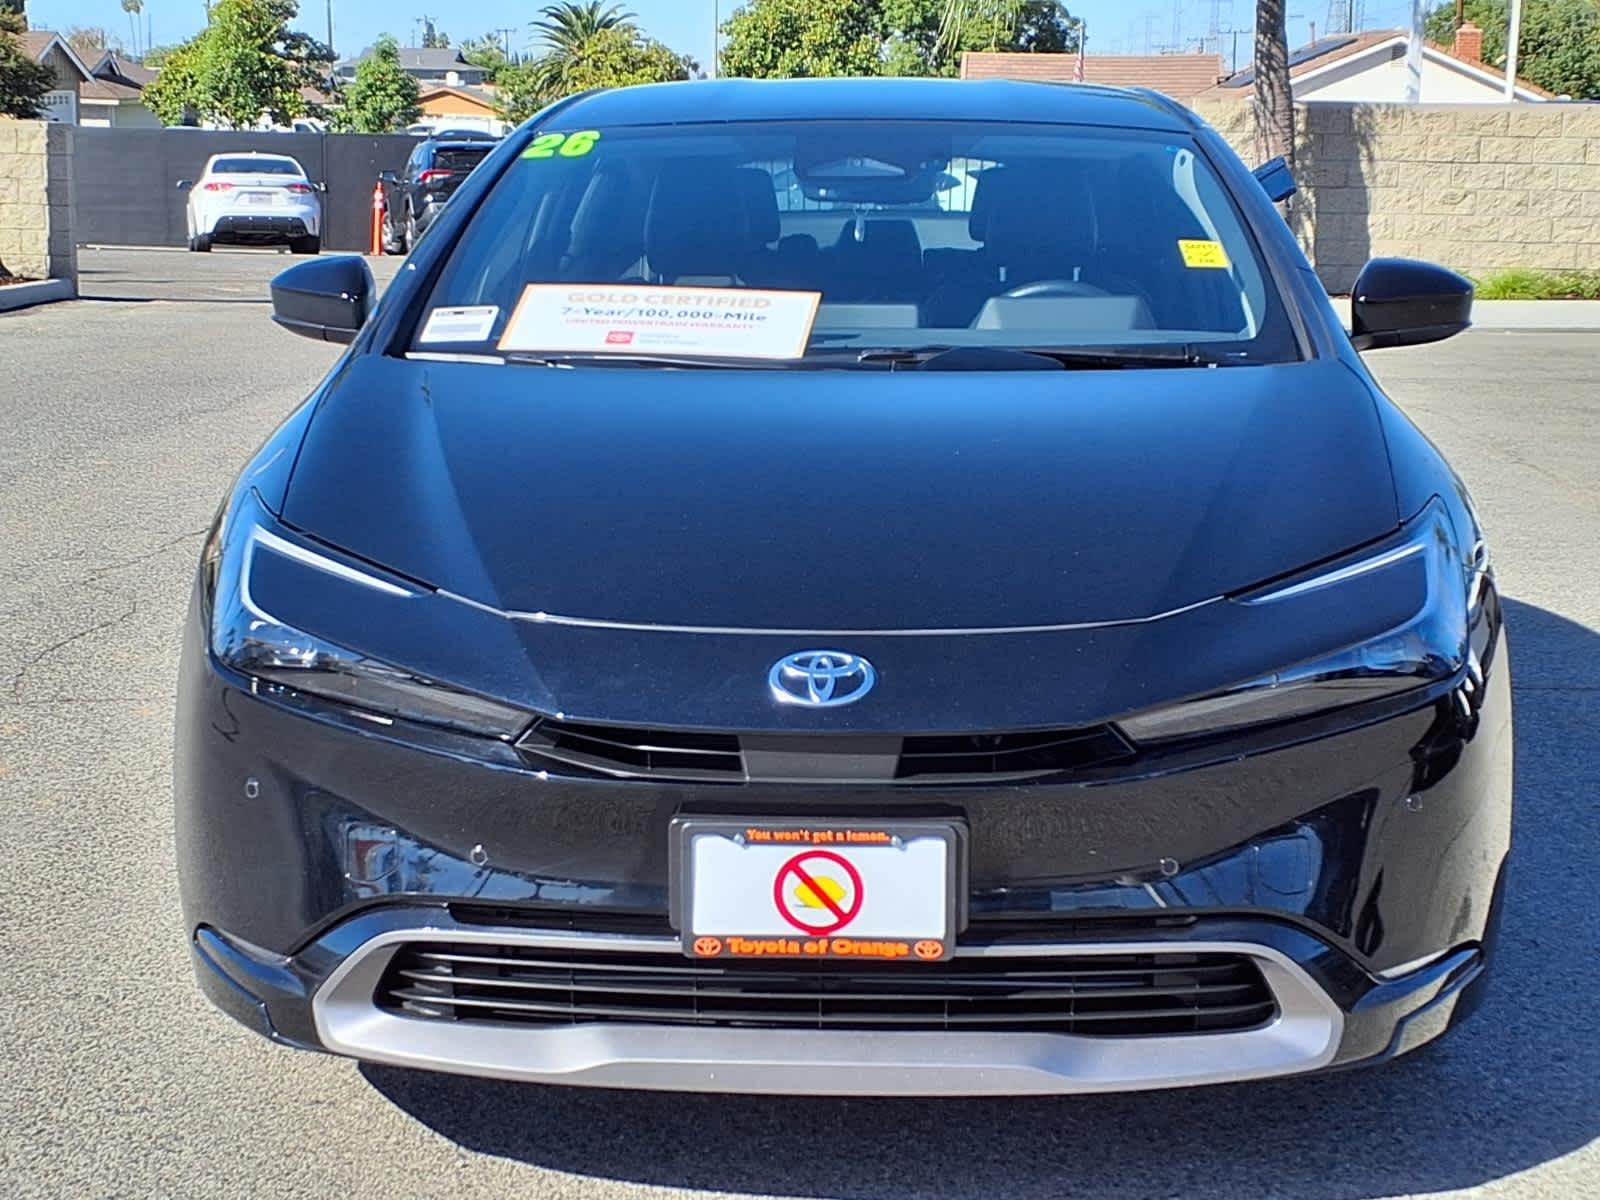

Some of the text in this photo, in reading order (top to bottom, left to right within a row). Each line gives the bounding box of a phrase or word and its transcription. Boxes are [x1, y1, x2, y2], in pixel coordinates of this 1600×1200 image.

[521, 130, 600, 159] 26
[567, 292, 771, 308] GOLD CERTIFIED
[747, 828, 890, 844] You won't get a lemon.
[726, 937, 909, 957] Toyota of Orange
